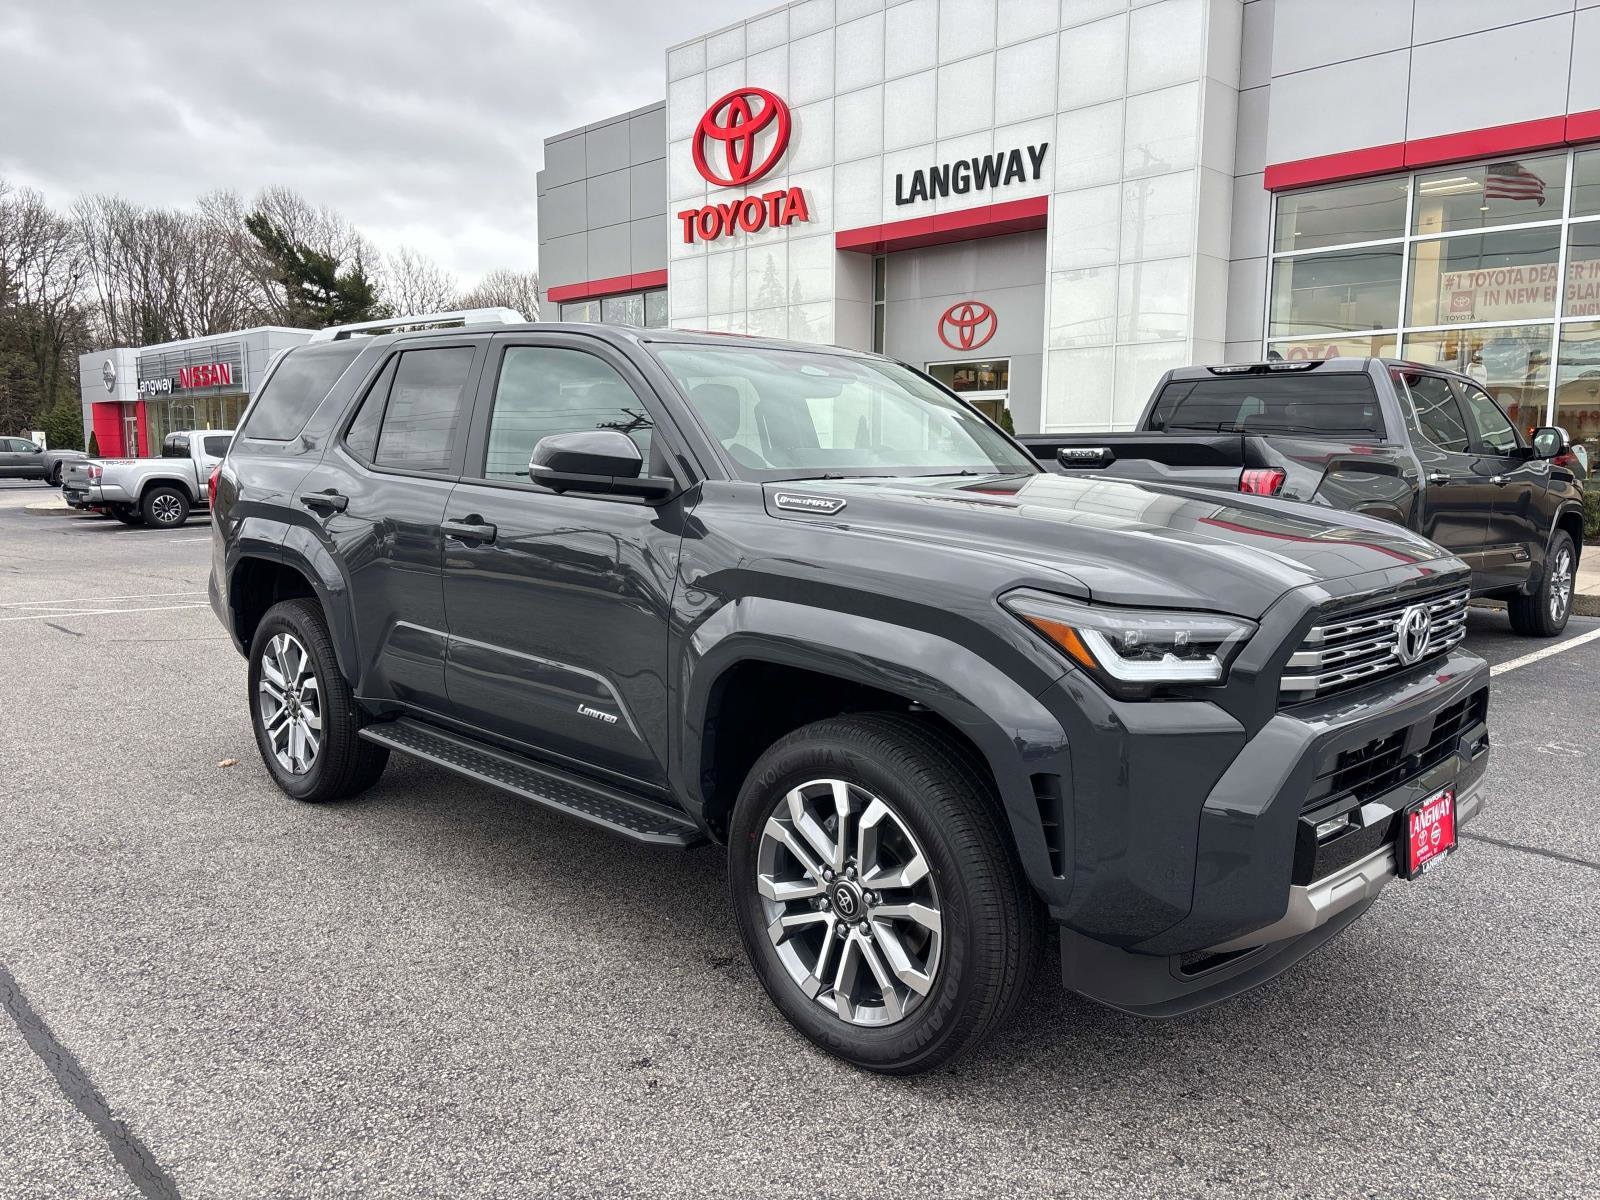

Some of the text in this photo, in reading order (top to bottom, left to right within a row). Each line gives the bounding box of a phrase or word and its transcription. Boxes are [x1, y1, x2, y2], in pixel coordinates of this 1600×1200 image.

[896, 143, 1048, 206] LANGWAY
[678, 187, 809, 244] TOYOTA
[1444, 274, 1462, 290] #1
[1468, 267, 1523, 288] TOYOTA
[1528, 263, 1584, 283] DEAER
[1483, 290, 1500, 306] IN
[1505, 286, 1540, 305] NEW
[1444, 314, 1476, 322] TOYOTA
[137, 363, 233, 395] Langway NISSAN
[1409, 798, 1451, 838] LANGWAY
